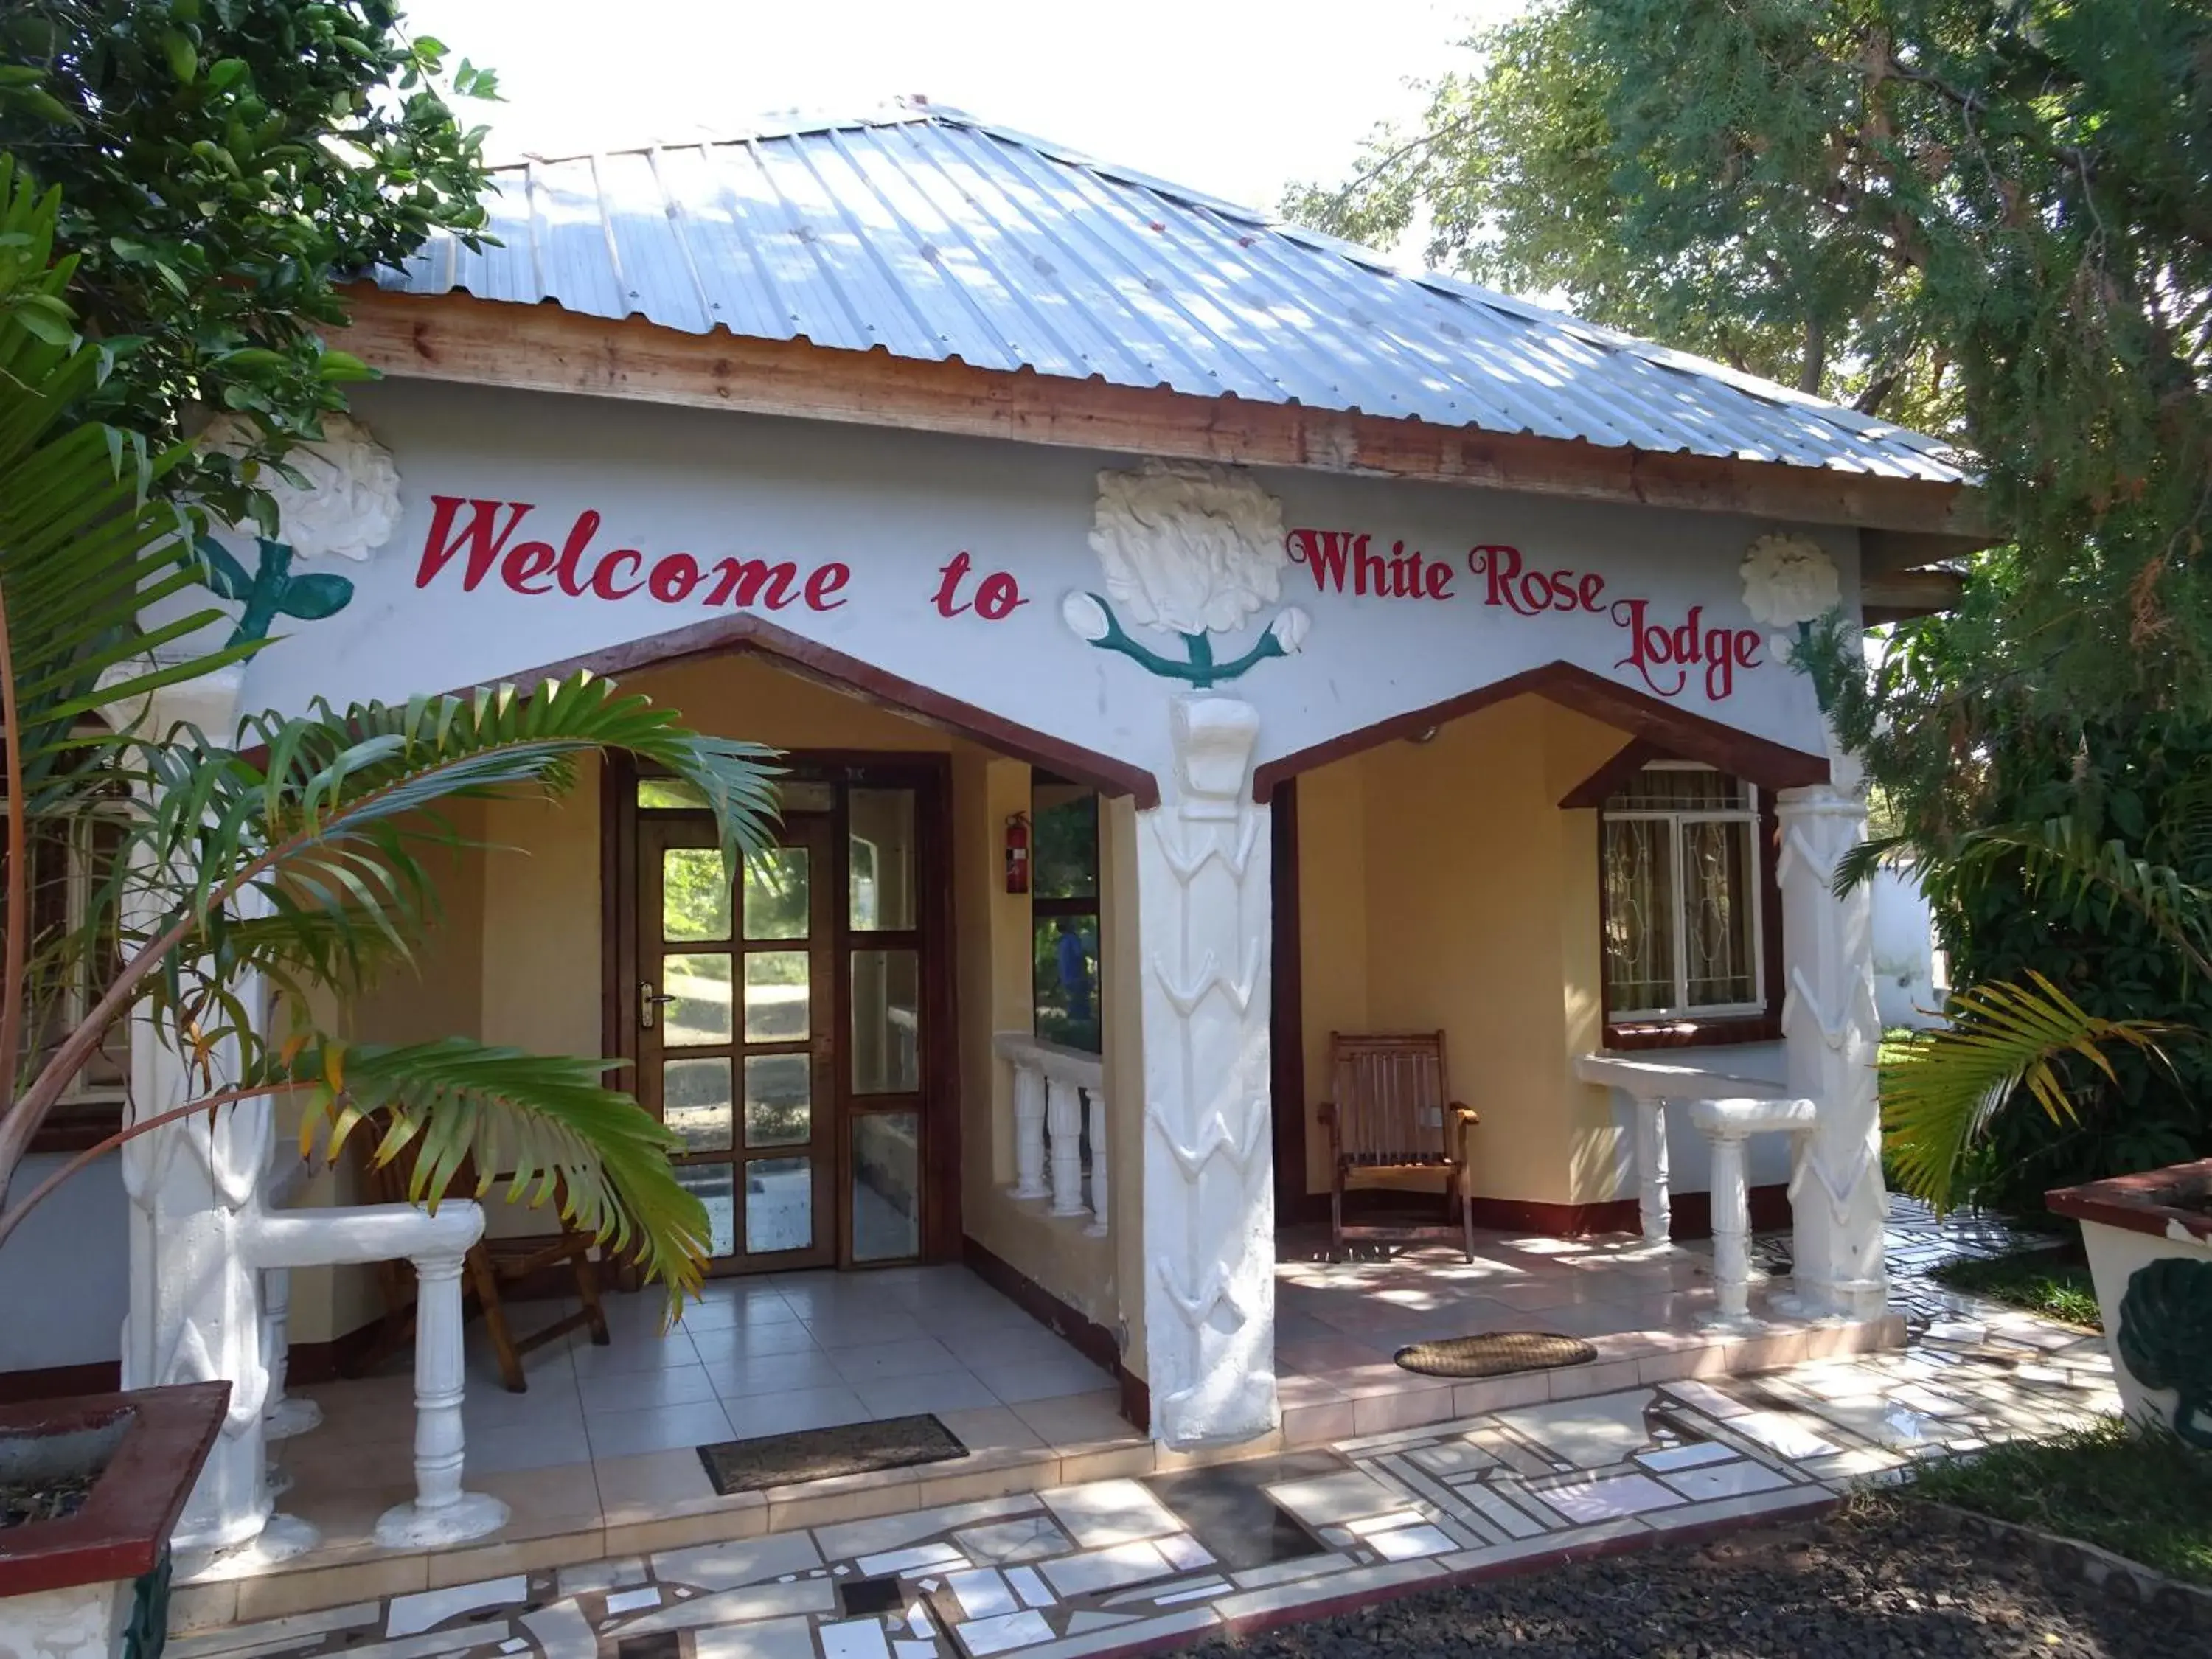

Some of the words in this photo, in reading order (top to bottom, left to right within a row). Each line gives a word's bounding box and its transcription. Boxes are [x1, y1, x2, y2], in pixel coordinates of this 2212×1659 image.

[415, 495, 850, 611] Welcome
[931, 552, 1029, 619] to
[1287, 529, 1455, 599] White
[1468, 545, 1607, 615] Rose
[1612, 599, 1763, 700] Lodge
